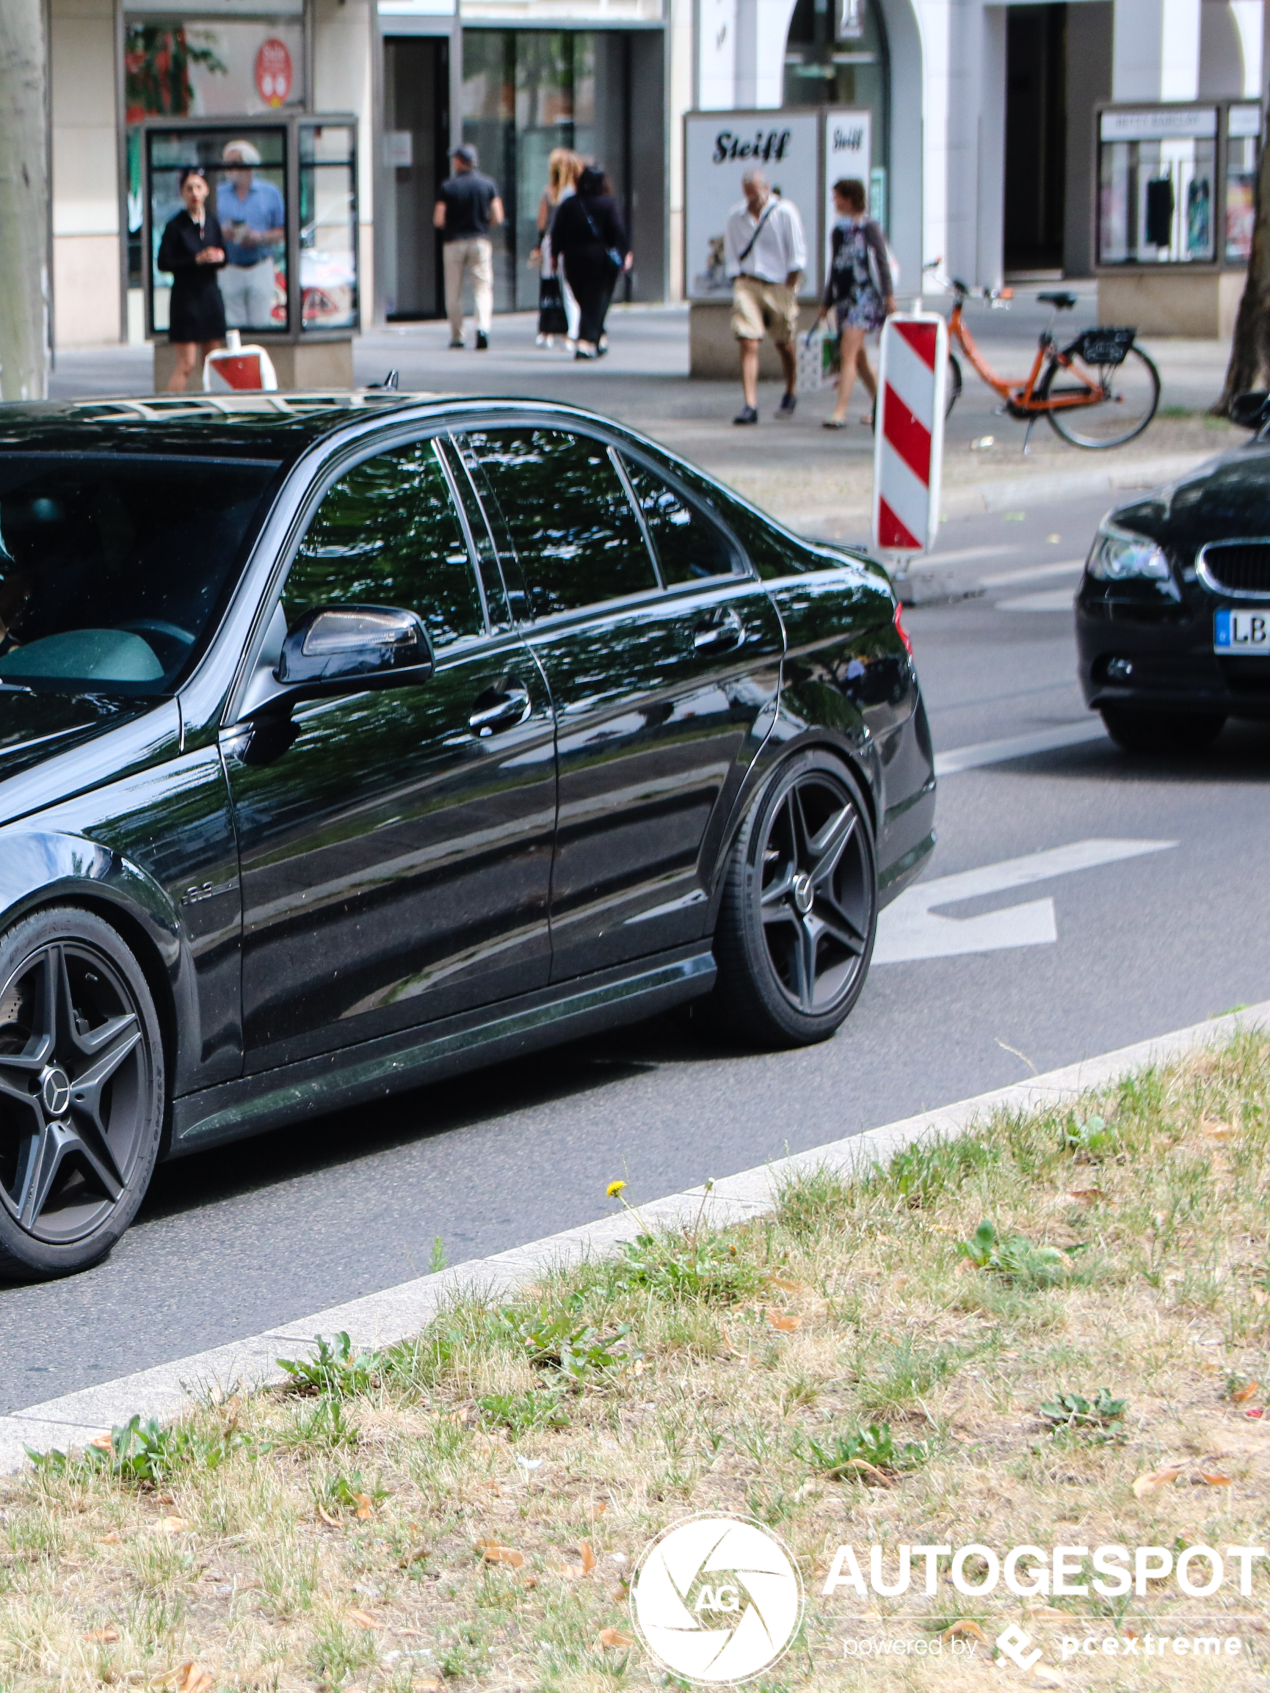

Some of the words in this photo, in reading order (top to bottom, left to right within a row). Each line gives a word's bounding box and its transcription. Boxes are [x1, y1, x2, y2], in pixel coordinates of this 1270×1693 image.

[713, 127, 792, 165] Steiff
[833, 128, 863, 153] Steiff
[1233, 617, 1267, 643] LB
